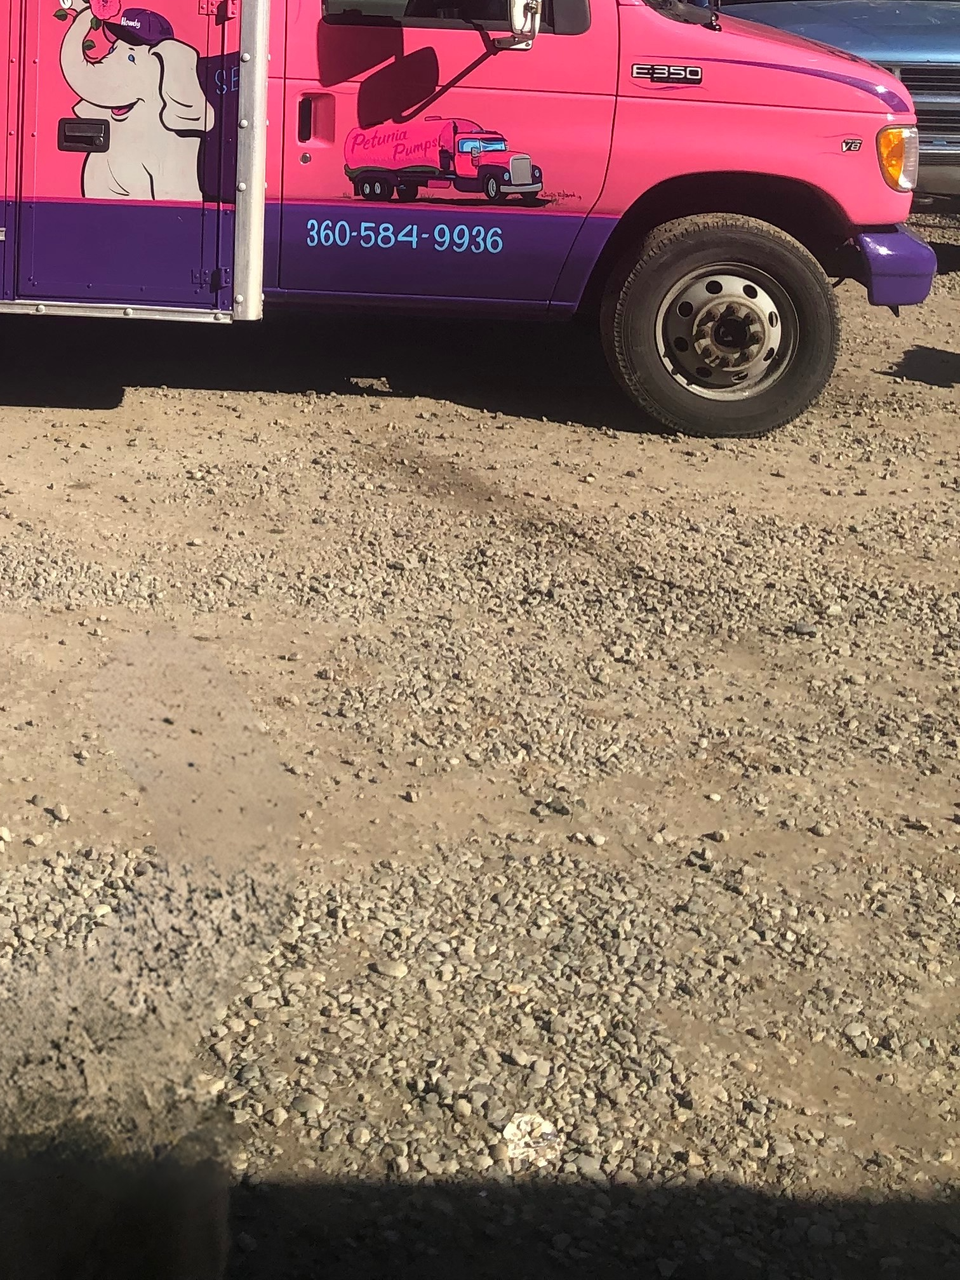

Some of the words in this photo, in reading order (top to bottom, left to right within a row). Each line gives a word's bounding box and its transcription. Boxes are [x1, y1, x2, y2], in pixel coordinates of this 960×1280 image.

[351, 130, 408, 155] Petunia
[393, 138, 438, 161] Pumps
[842, 142, 861, 152] V8
[306, 219, 504, 254] 360-584-9936
